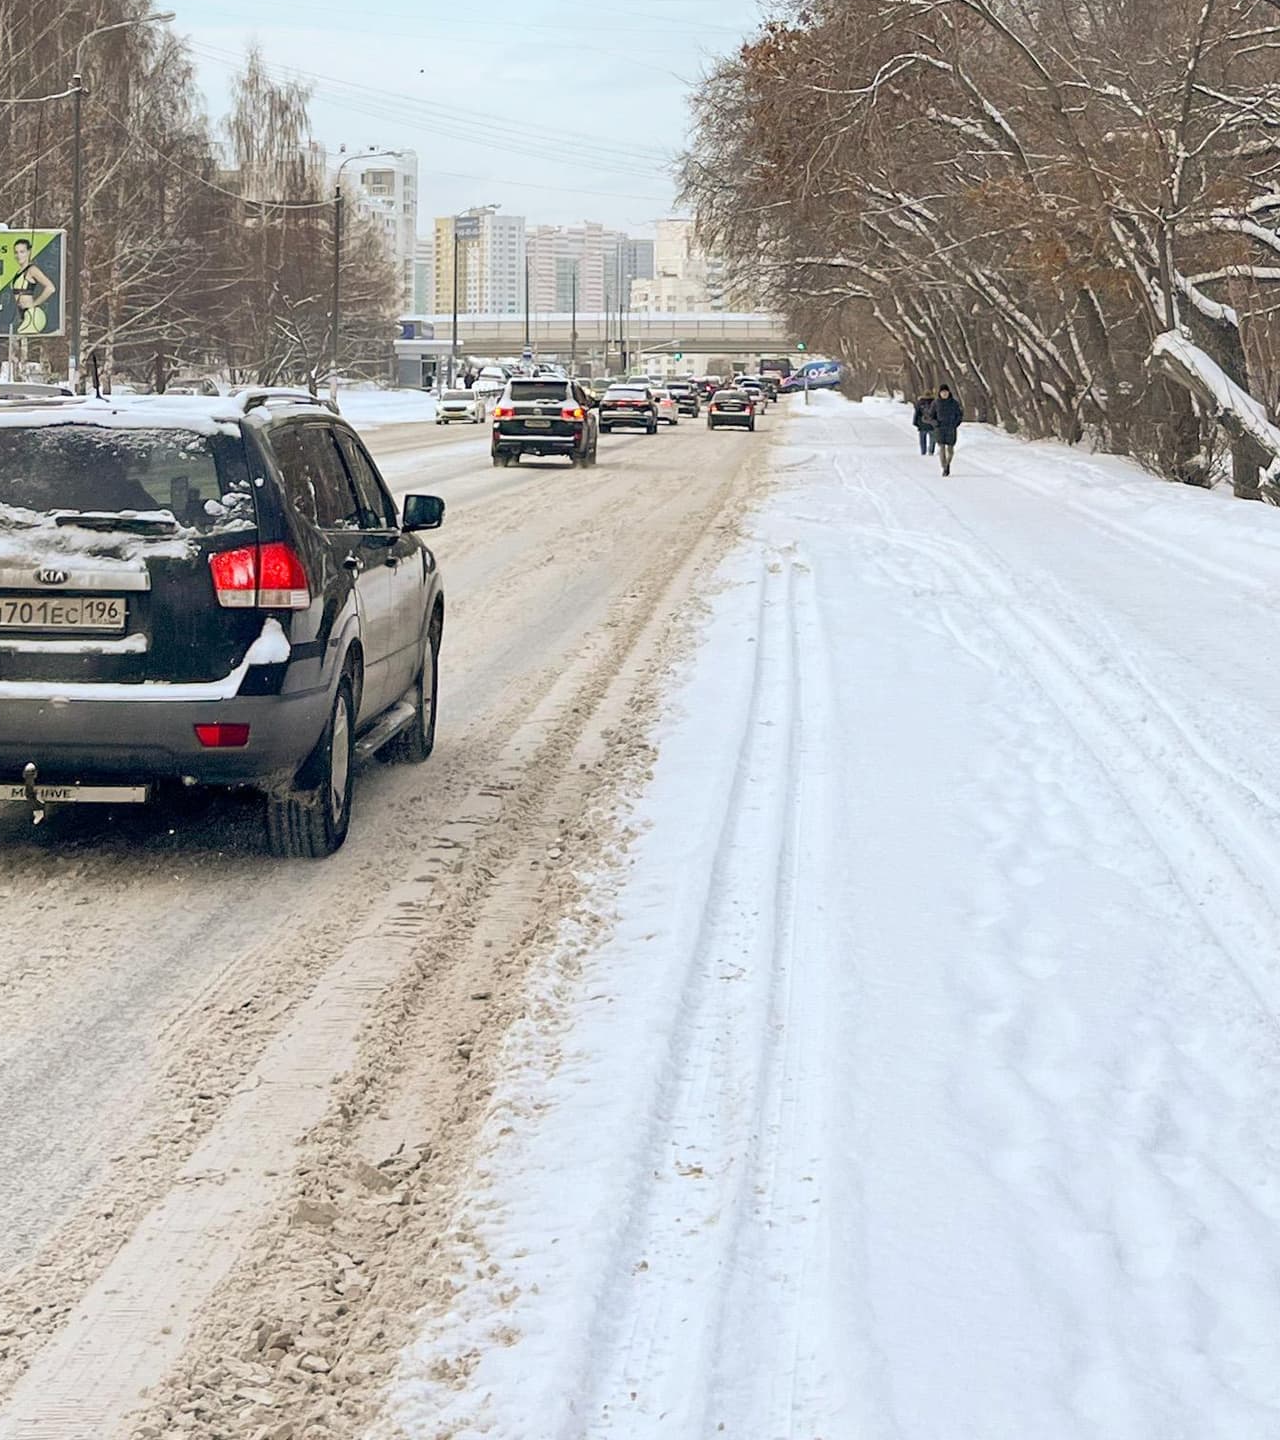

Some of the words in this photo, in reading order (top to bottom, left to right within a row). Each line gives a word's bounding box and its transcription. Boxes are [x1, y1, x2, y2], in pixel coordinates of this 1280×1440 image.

[40, 571, 65, 582] KIA
[84, 601, 119, 619] 196
[11, 787, 73, 799] MHAVE
